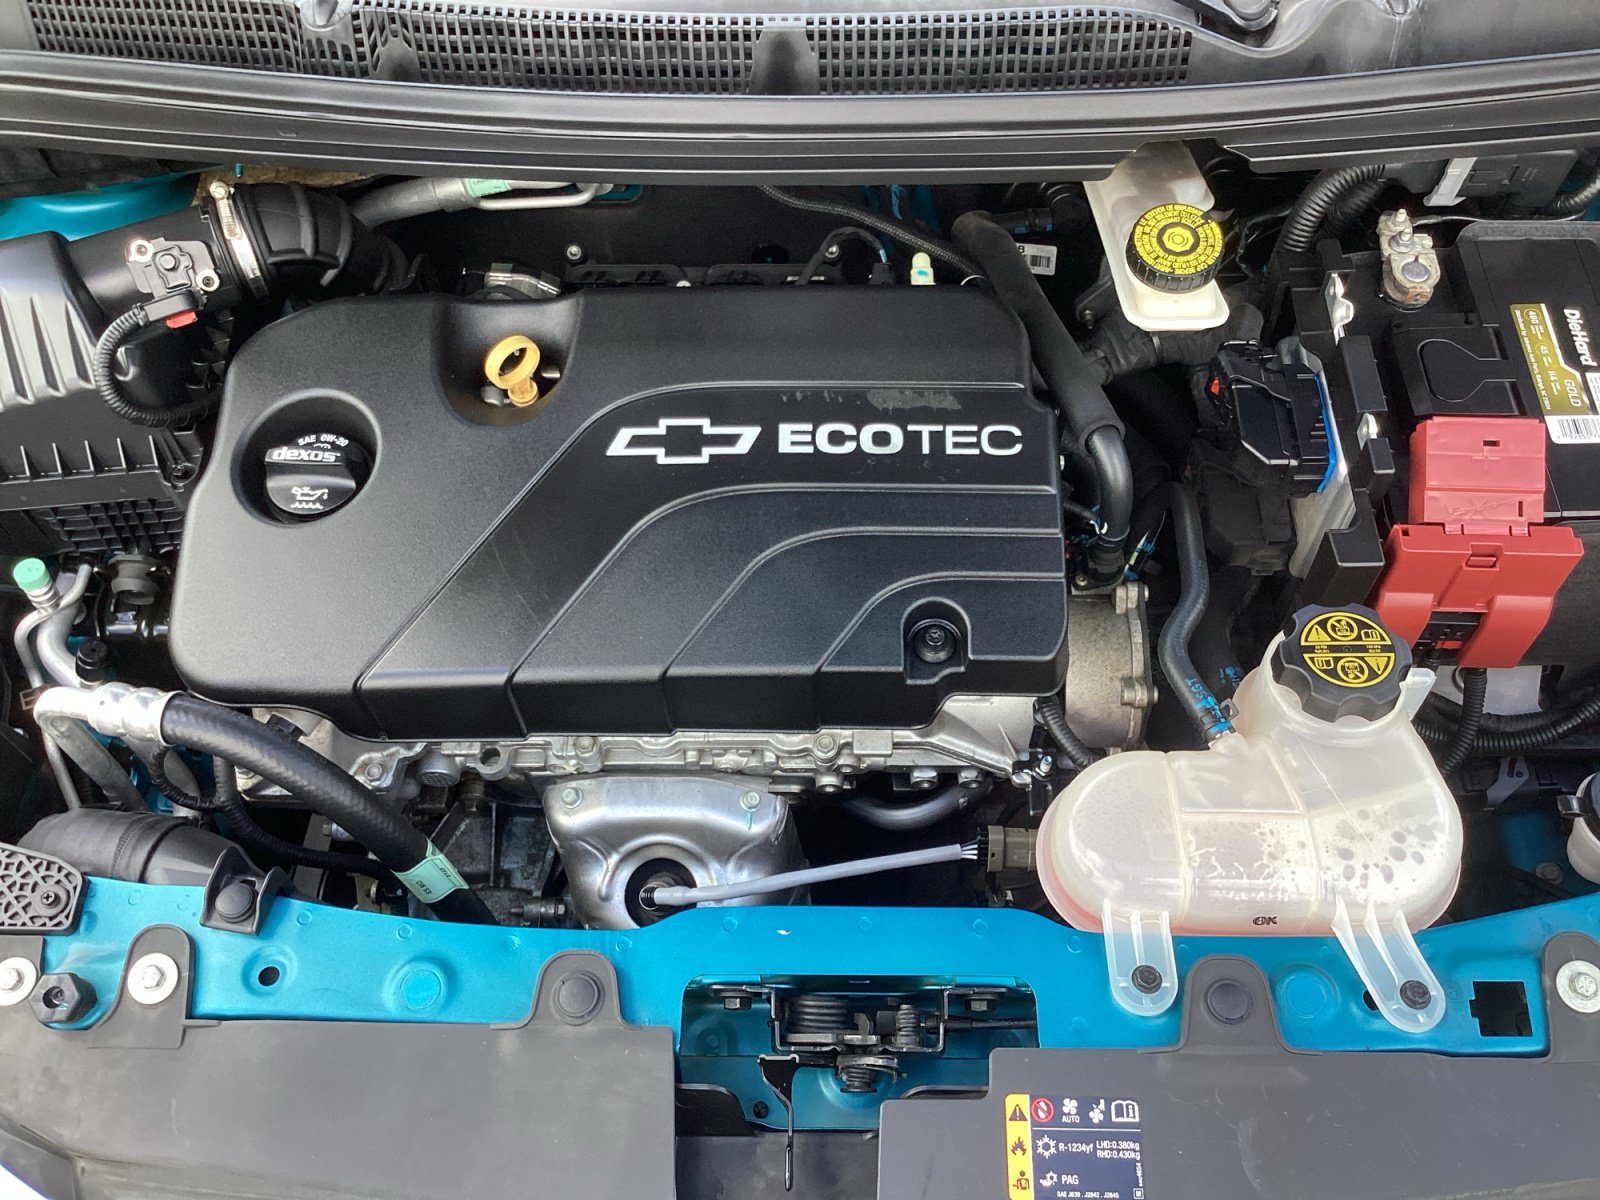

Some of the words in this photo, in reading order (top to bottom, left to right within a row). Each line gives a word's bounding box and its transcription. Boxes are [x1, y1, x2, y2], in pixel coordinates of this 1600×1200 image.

[1563, 310, 1598, 366] DieHard
[1547, 371, 1557, 380] H4
[1564, 380, 1582, 407] GOLD
[298, 435, 316, 446] SAE
[321, 434, 349, 447] 0W-20
[778, 423, 1024, 455] ECOTEC
[273, 447, 337, 462] dexos
[1062, 1115, 1080, 1123] AUTO
[1059, 1143, 1093, 1154] R-1234yf
[1096, 1141, 1139, 1150] LHD:0.380kg
[1097, 1150, 1140, 1160] RHD:0.430kg
[1062, 1175, 1078, 1184] PAG
